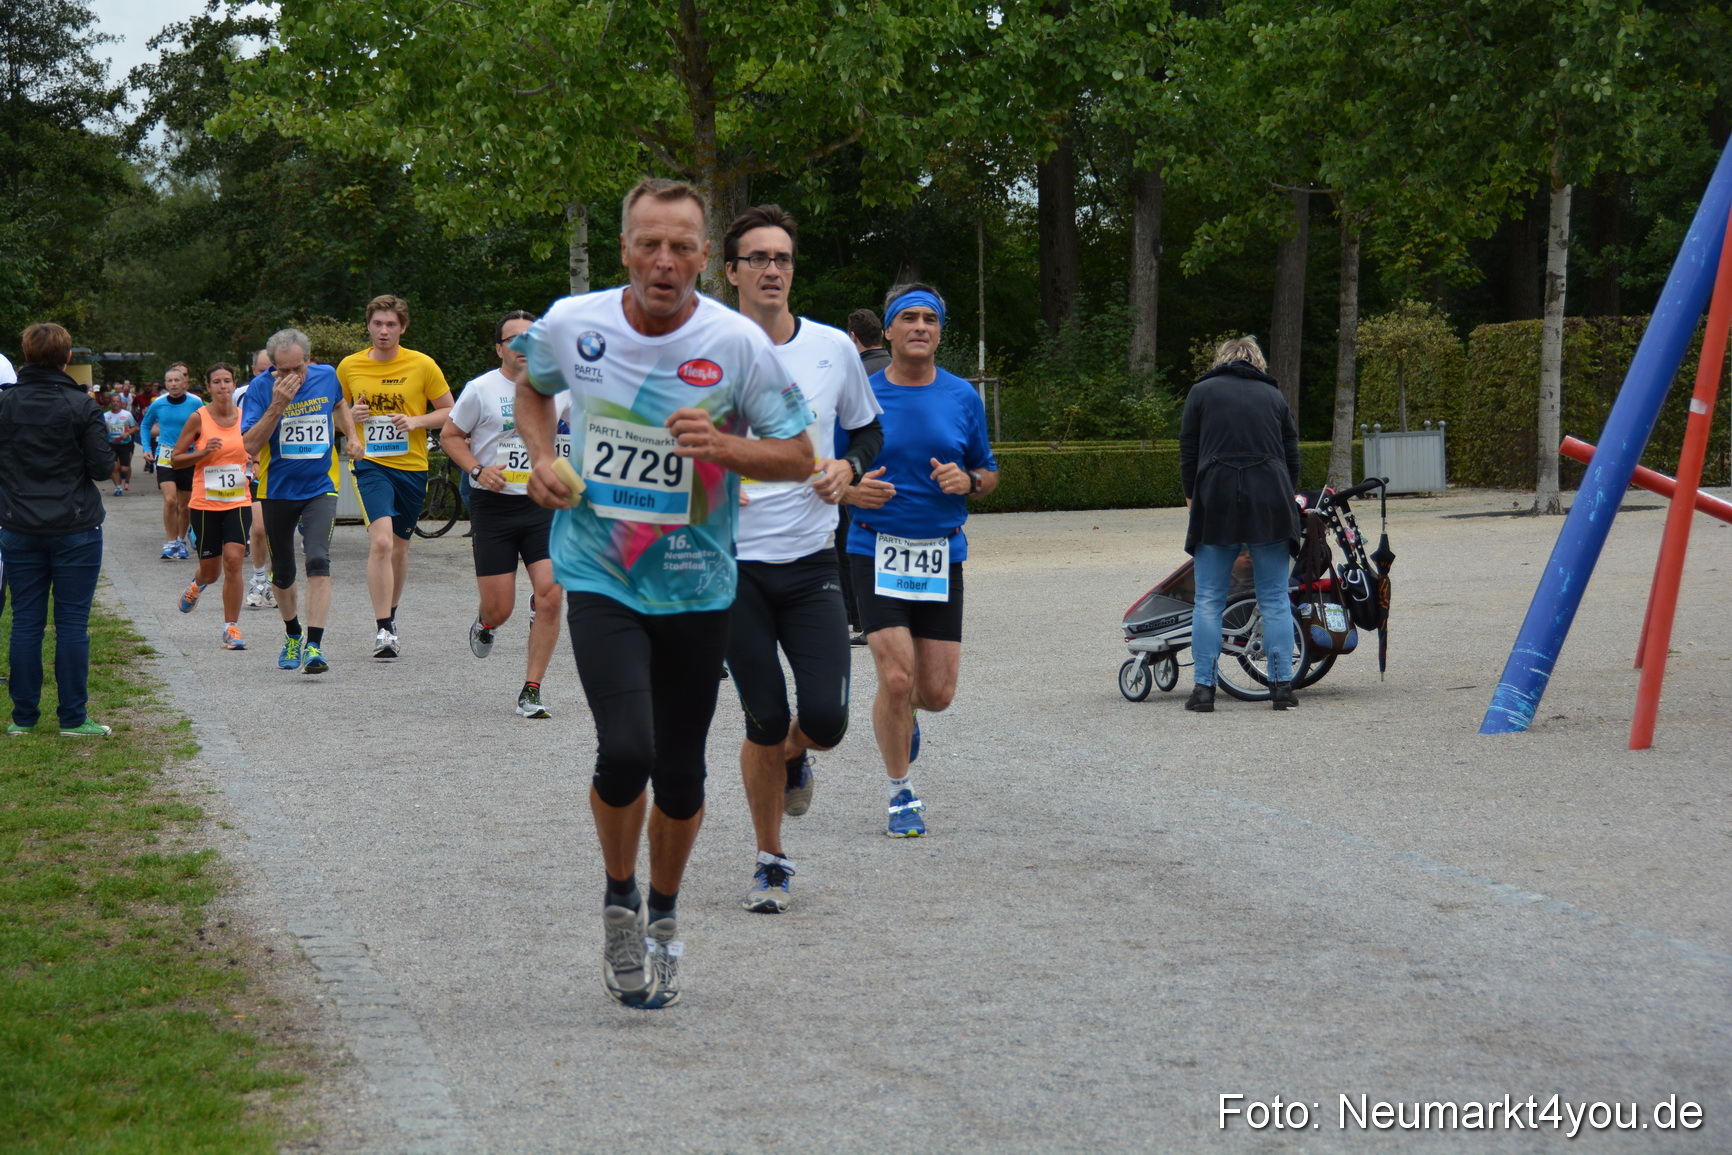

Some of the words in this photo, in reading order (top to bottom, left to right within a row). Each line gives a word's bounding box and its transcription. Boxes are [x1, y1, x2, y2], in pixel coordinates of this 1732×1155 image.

[574, 364, 604, 378] PARTL
[282, 404, 322, 419] STADTLAUF
[285, 425, 325, 442] 2512
[368, 425, 405, 441] 2732
[589, 423, 623, 439] PARTL
[625, 431, 676, 447] Neumarkt
[373, 443, 400, 451] Christian
[593, 441, 684, 488] 2729
[218, 473, 236, 488] 13
[612, 489, 656, 510] Ulrich
[667, 534, 692, 551] 16.
[878, 535, 903, 545] PARTL
[904, 539, 936, 547] Neumarkt
[883, 546, 943, 575] 2149
[896, 578, 928, 591] Robert
